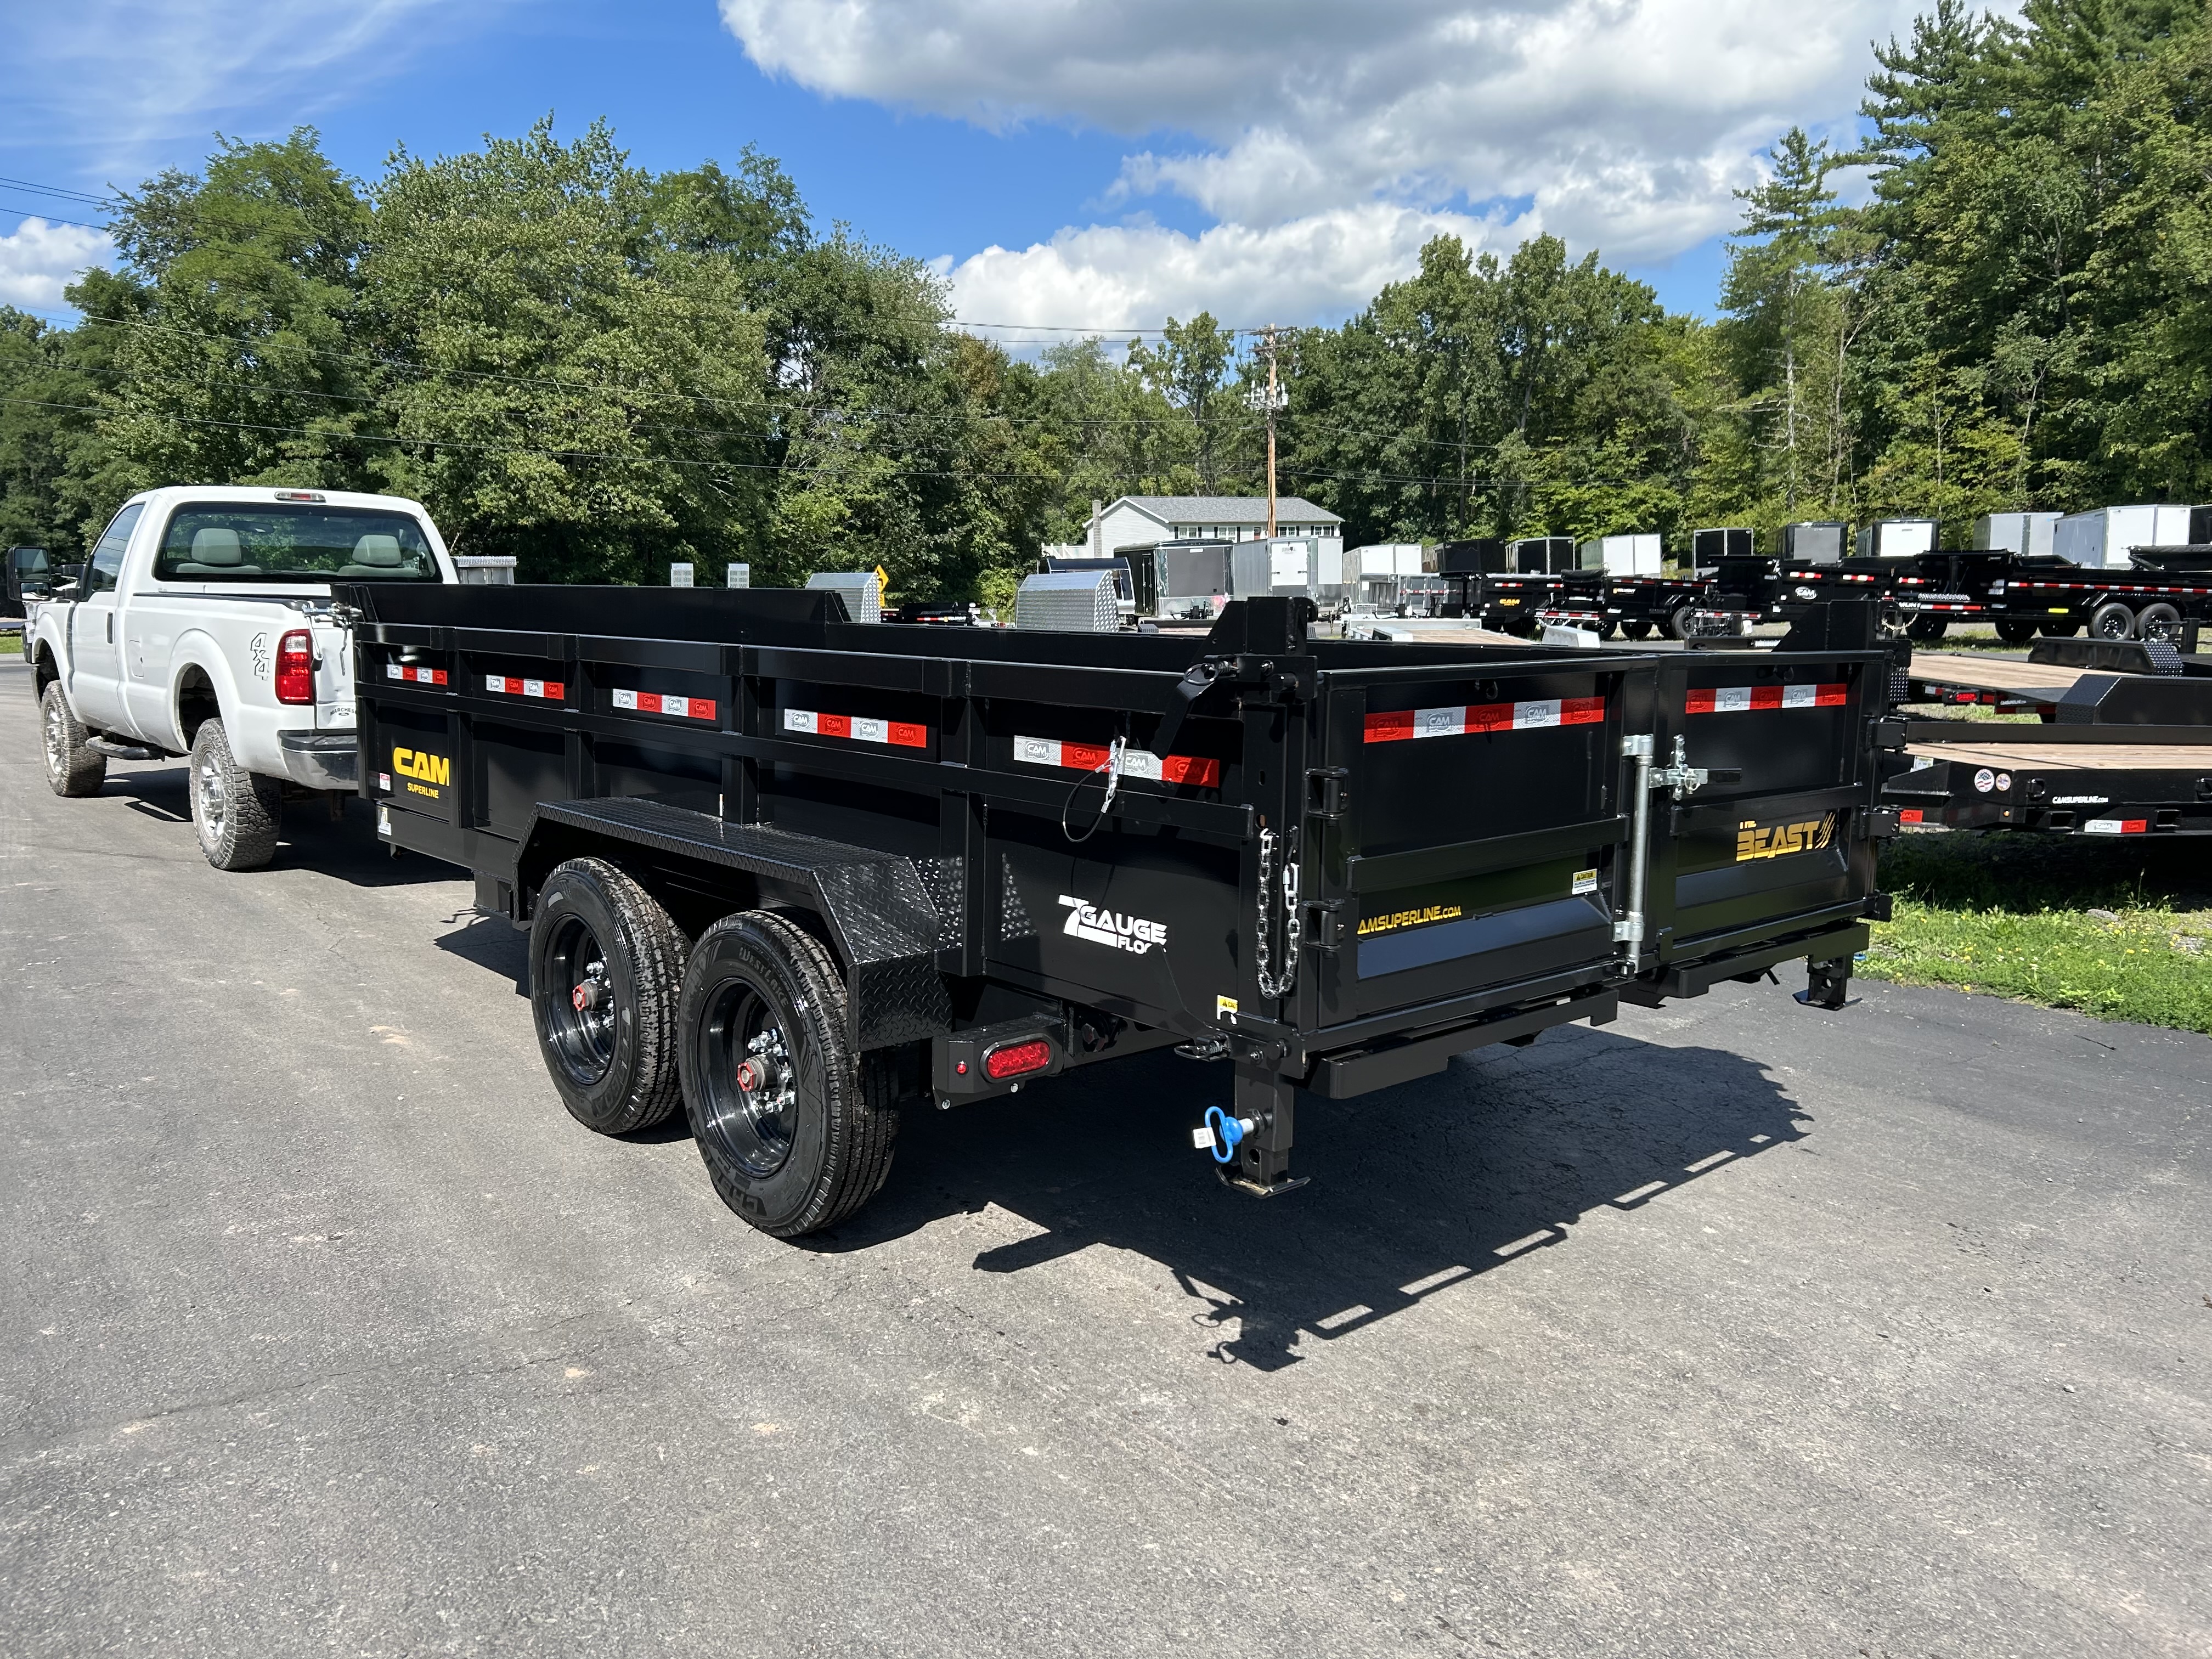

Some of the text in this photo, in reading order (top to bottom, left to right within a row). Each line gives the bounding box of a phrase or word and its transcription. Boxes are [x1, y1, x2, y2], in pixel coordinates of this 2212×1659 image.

[393, 747, 450, 787] CAM
[1028, 744, 1047, 756] CAM
[1075, 751, 1096, 761] CAM
[1125, 757, 1146, 768] CAM
[407, 782, 439, 799] SUPERLINE
[1736, 821, 1820, 861] BEAST
[1080, 905, 1167, 945] GAUGE
[1357, 906, 1462, 934] AMSUPERLINE.COM
[1118, 935, 1166, 955] FLO
